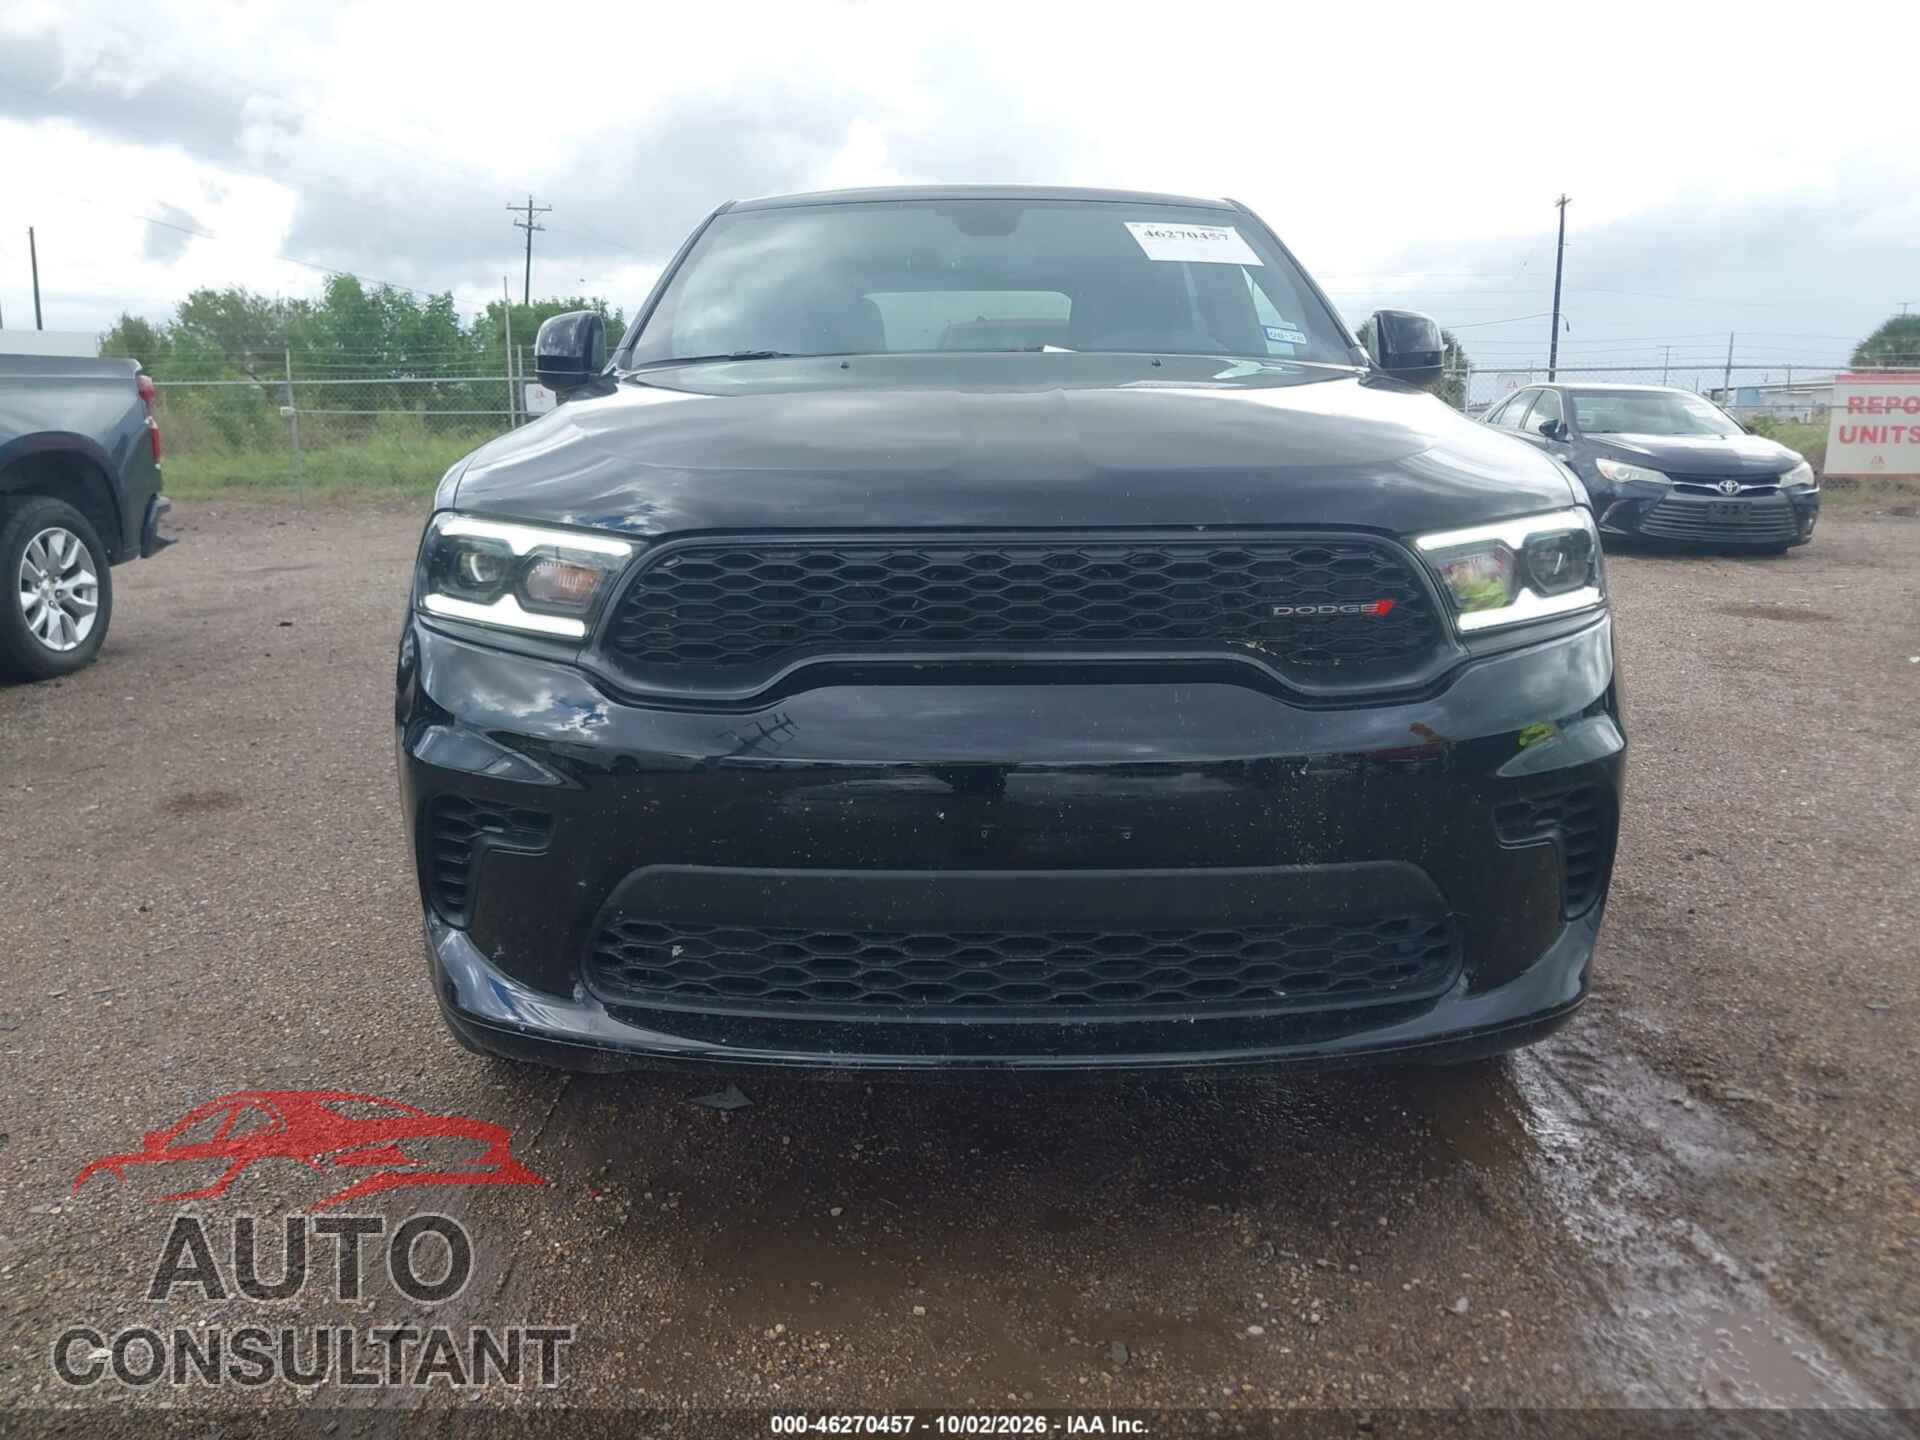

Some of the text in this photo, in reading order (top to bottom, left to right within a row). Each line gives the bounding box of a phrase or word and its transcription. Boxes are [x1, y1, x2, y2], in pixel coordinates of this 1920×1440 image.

[1847, 395, 1920, 415] REPO
[1839, 425, 1920, 445] UNITS
[1272, 603, 1380, 617] DODGE
